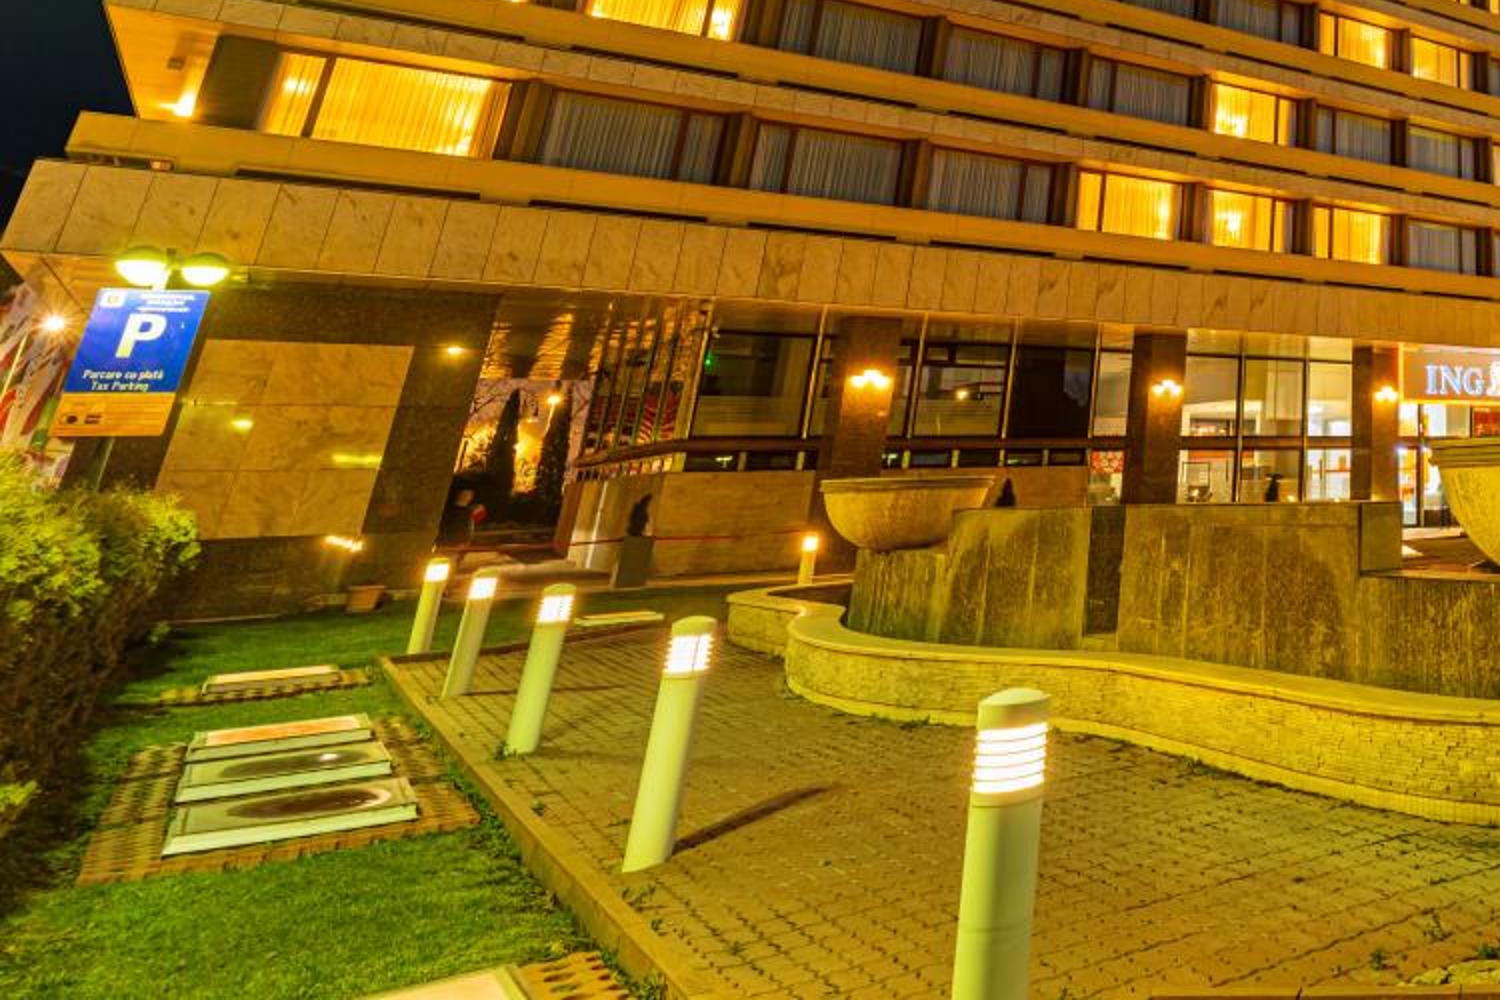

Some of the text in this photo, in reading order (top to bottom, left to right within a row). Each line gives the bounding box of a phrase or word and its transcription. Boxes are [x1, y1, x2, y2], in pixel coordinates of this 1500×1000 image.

[115, 313, 167, 358] P
[82, 370, 122, 380] Parcare
[124, 371, 137, 380] cu
[1425, 364, 1485, 396] ING
[91, 381, 149, 392] Tax Parking
